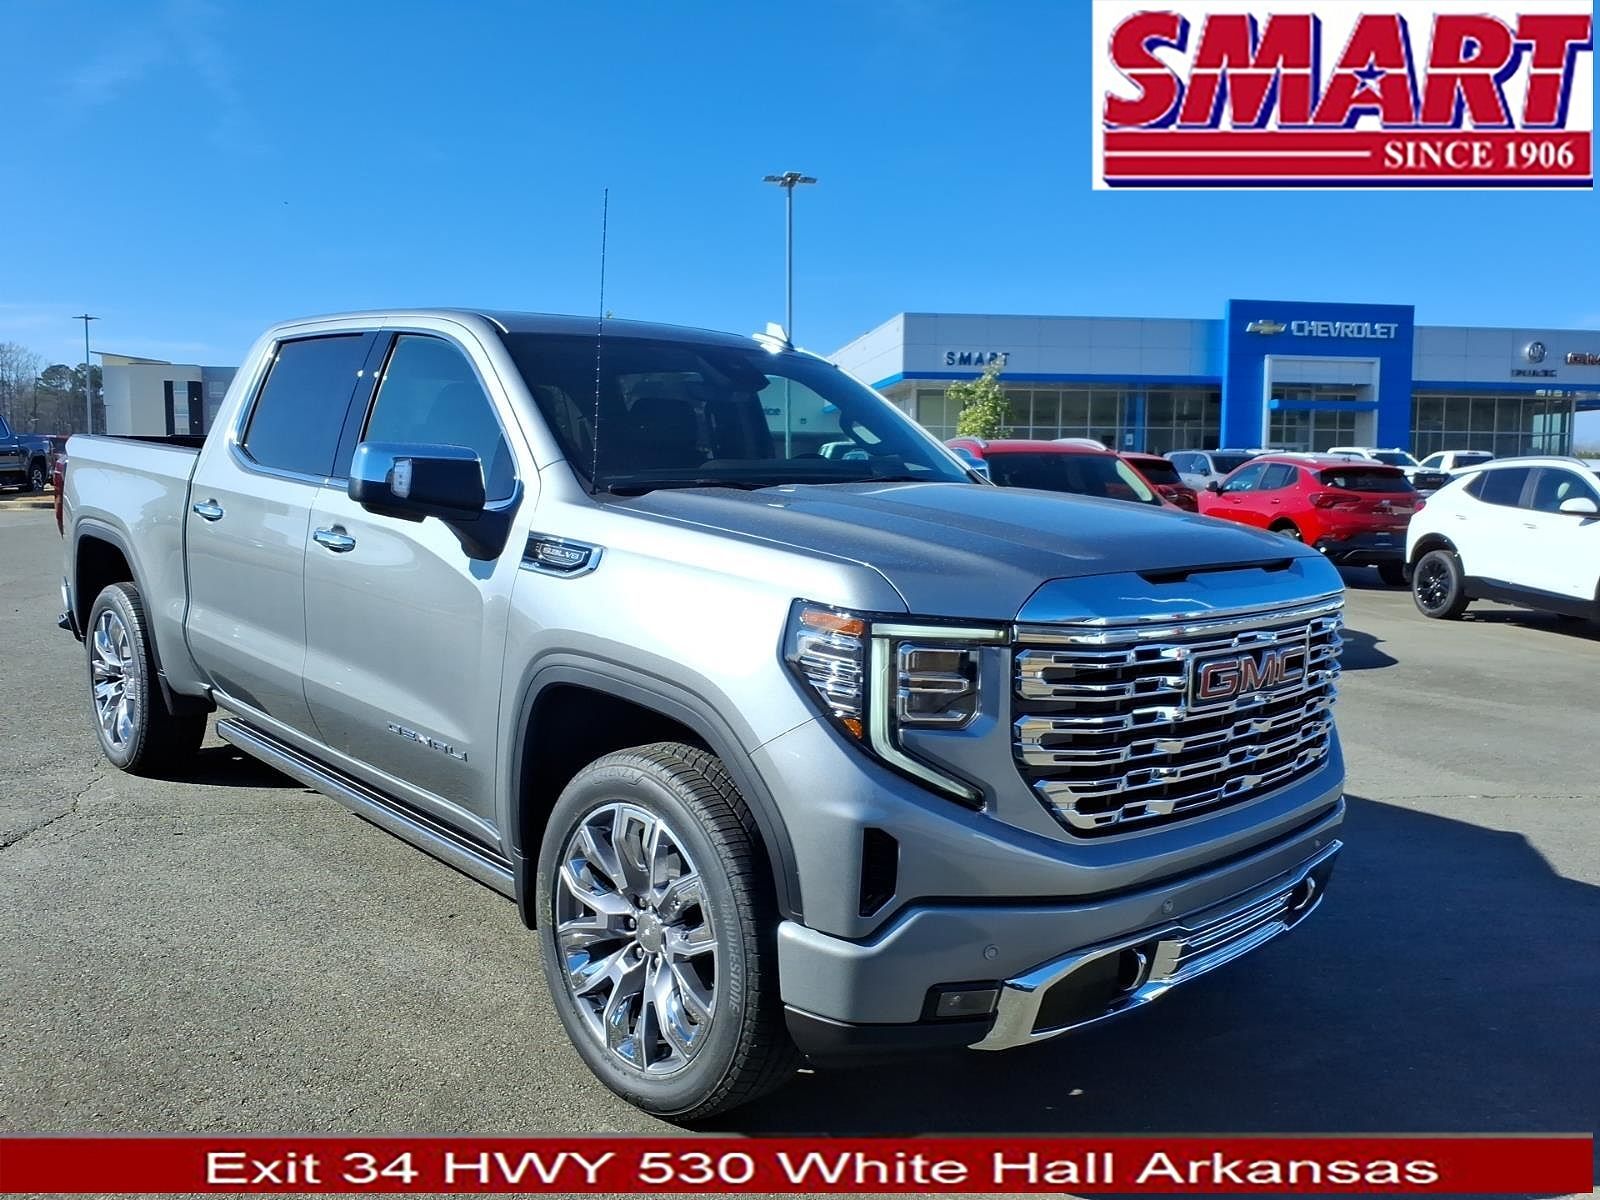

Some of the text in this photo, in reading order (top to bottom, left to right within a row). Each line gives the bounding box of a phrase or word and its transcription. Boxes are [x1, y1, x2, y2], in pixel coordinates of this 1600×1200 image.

[1291, 320, 1398, 338] CHEVROLET
[944, 351, 1010, 366] SMART
[1199, 645, 1306, 699] GMC
